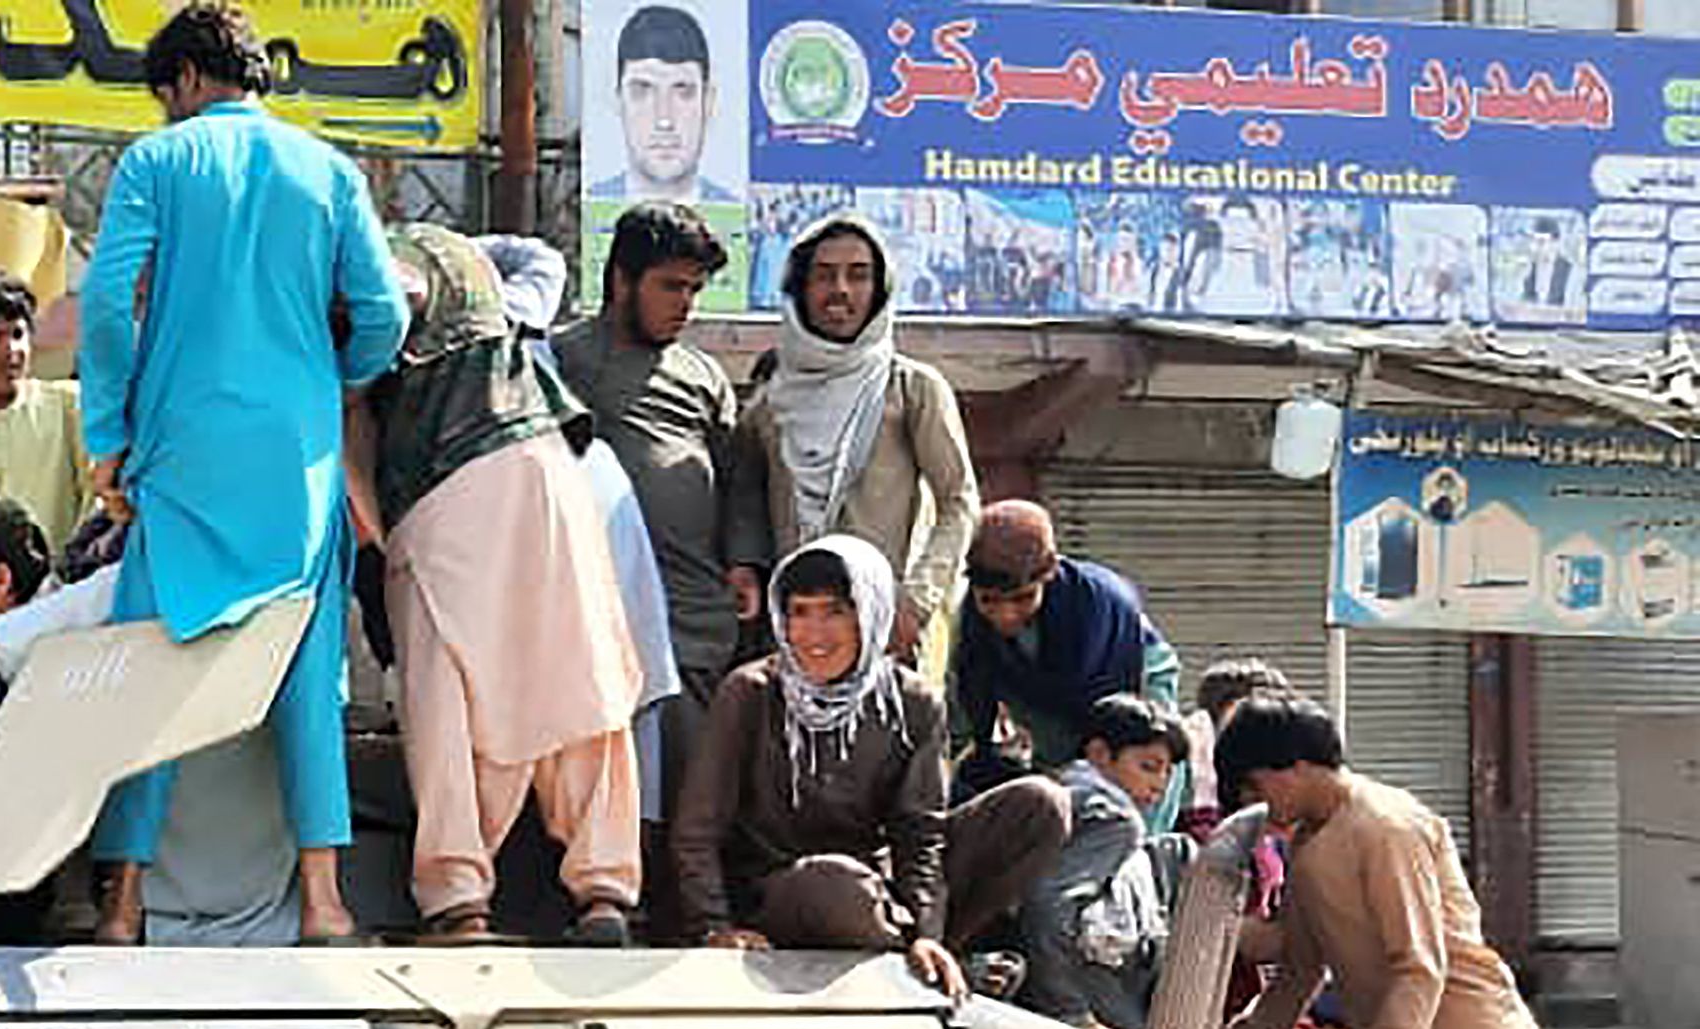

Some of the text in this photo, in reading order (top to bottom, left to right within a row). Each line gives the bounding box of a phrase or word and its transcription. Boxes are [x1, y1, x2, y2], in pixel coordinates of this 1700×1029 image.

[873, 18, 1104, 121] مرکز
[1410, 57, 1612, 140] همدرد
[924, 148, 1456, 195] Hamdard Educational Center
